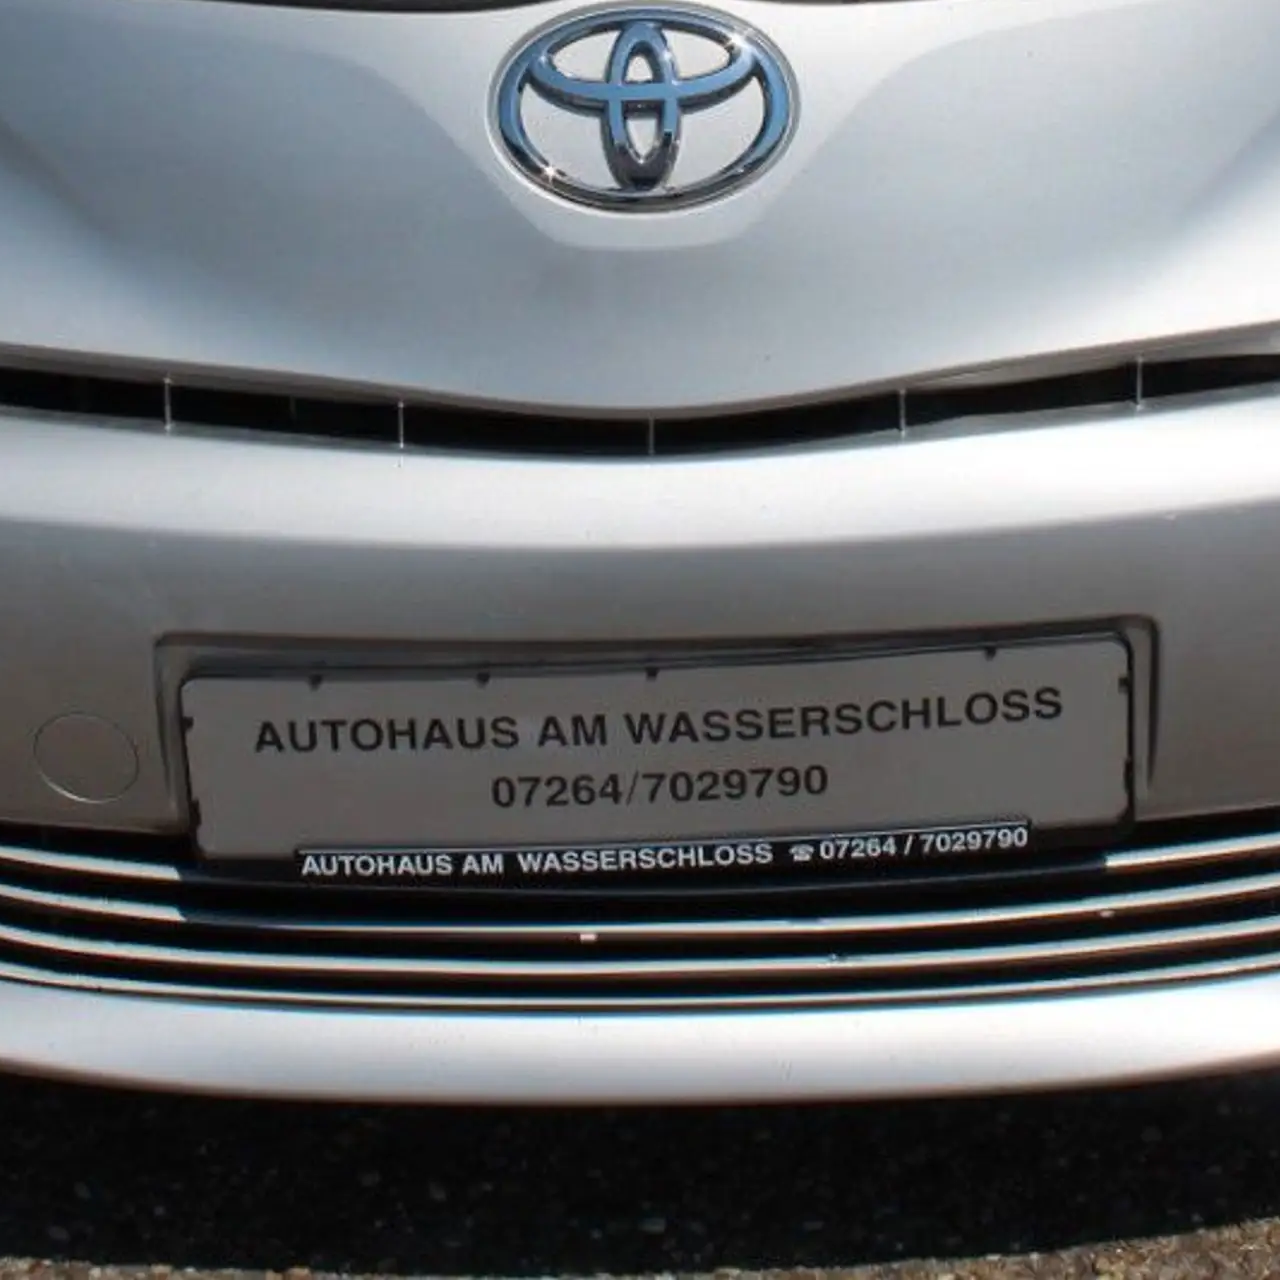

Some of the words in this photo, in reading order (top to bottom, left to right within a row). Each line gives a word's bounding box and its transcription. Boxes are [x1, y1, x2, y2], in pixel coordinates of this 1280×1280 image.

[254, 716, 520, 753] AUTOHAUS
[537, 713, 608, 748] AM
[623, 686, 1063, 745] WASSERSCHLOSS
[491, 764, 829, 809] 07264/7029790
[301, 852, 453, 877] AUTOHAUS
[461, 850, 505, 875] AM
[517, 842, 774, 873] WASSERSCHLOSS
[818, 838, 898, 860] 07264
[921, 826, 1029, 854] 7029790
